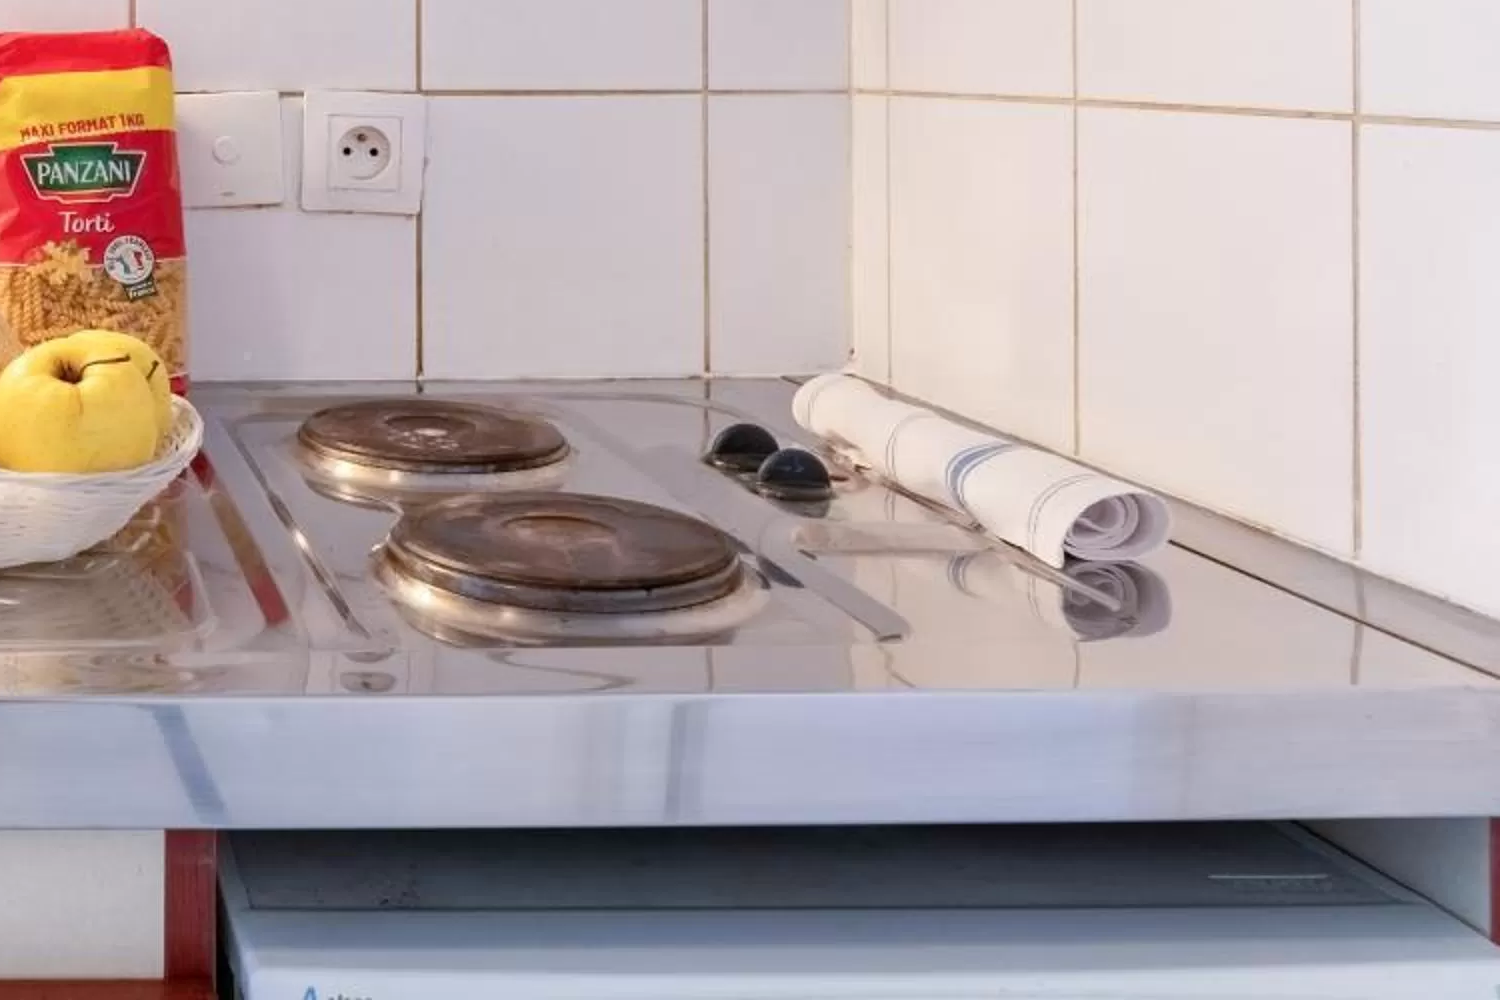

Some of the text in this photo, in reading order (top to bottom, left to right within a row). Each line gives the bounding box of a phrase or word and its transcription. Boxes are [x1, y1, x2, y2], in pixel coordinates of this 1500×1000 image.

[19, 123, 55, 142] MAXI
[57, 115, 118, 136] FORMAT
[36, 159, 132, 185] PANZANI
[58, 211, 116, 233] Torti
